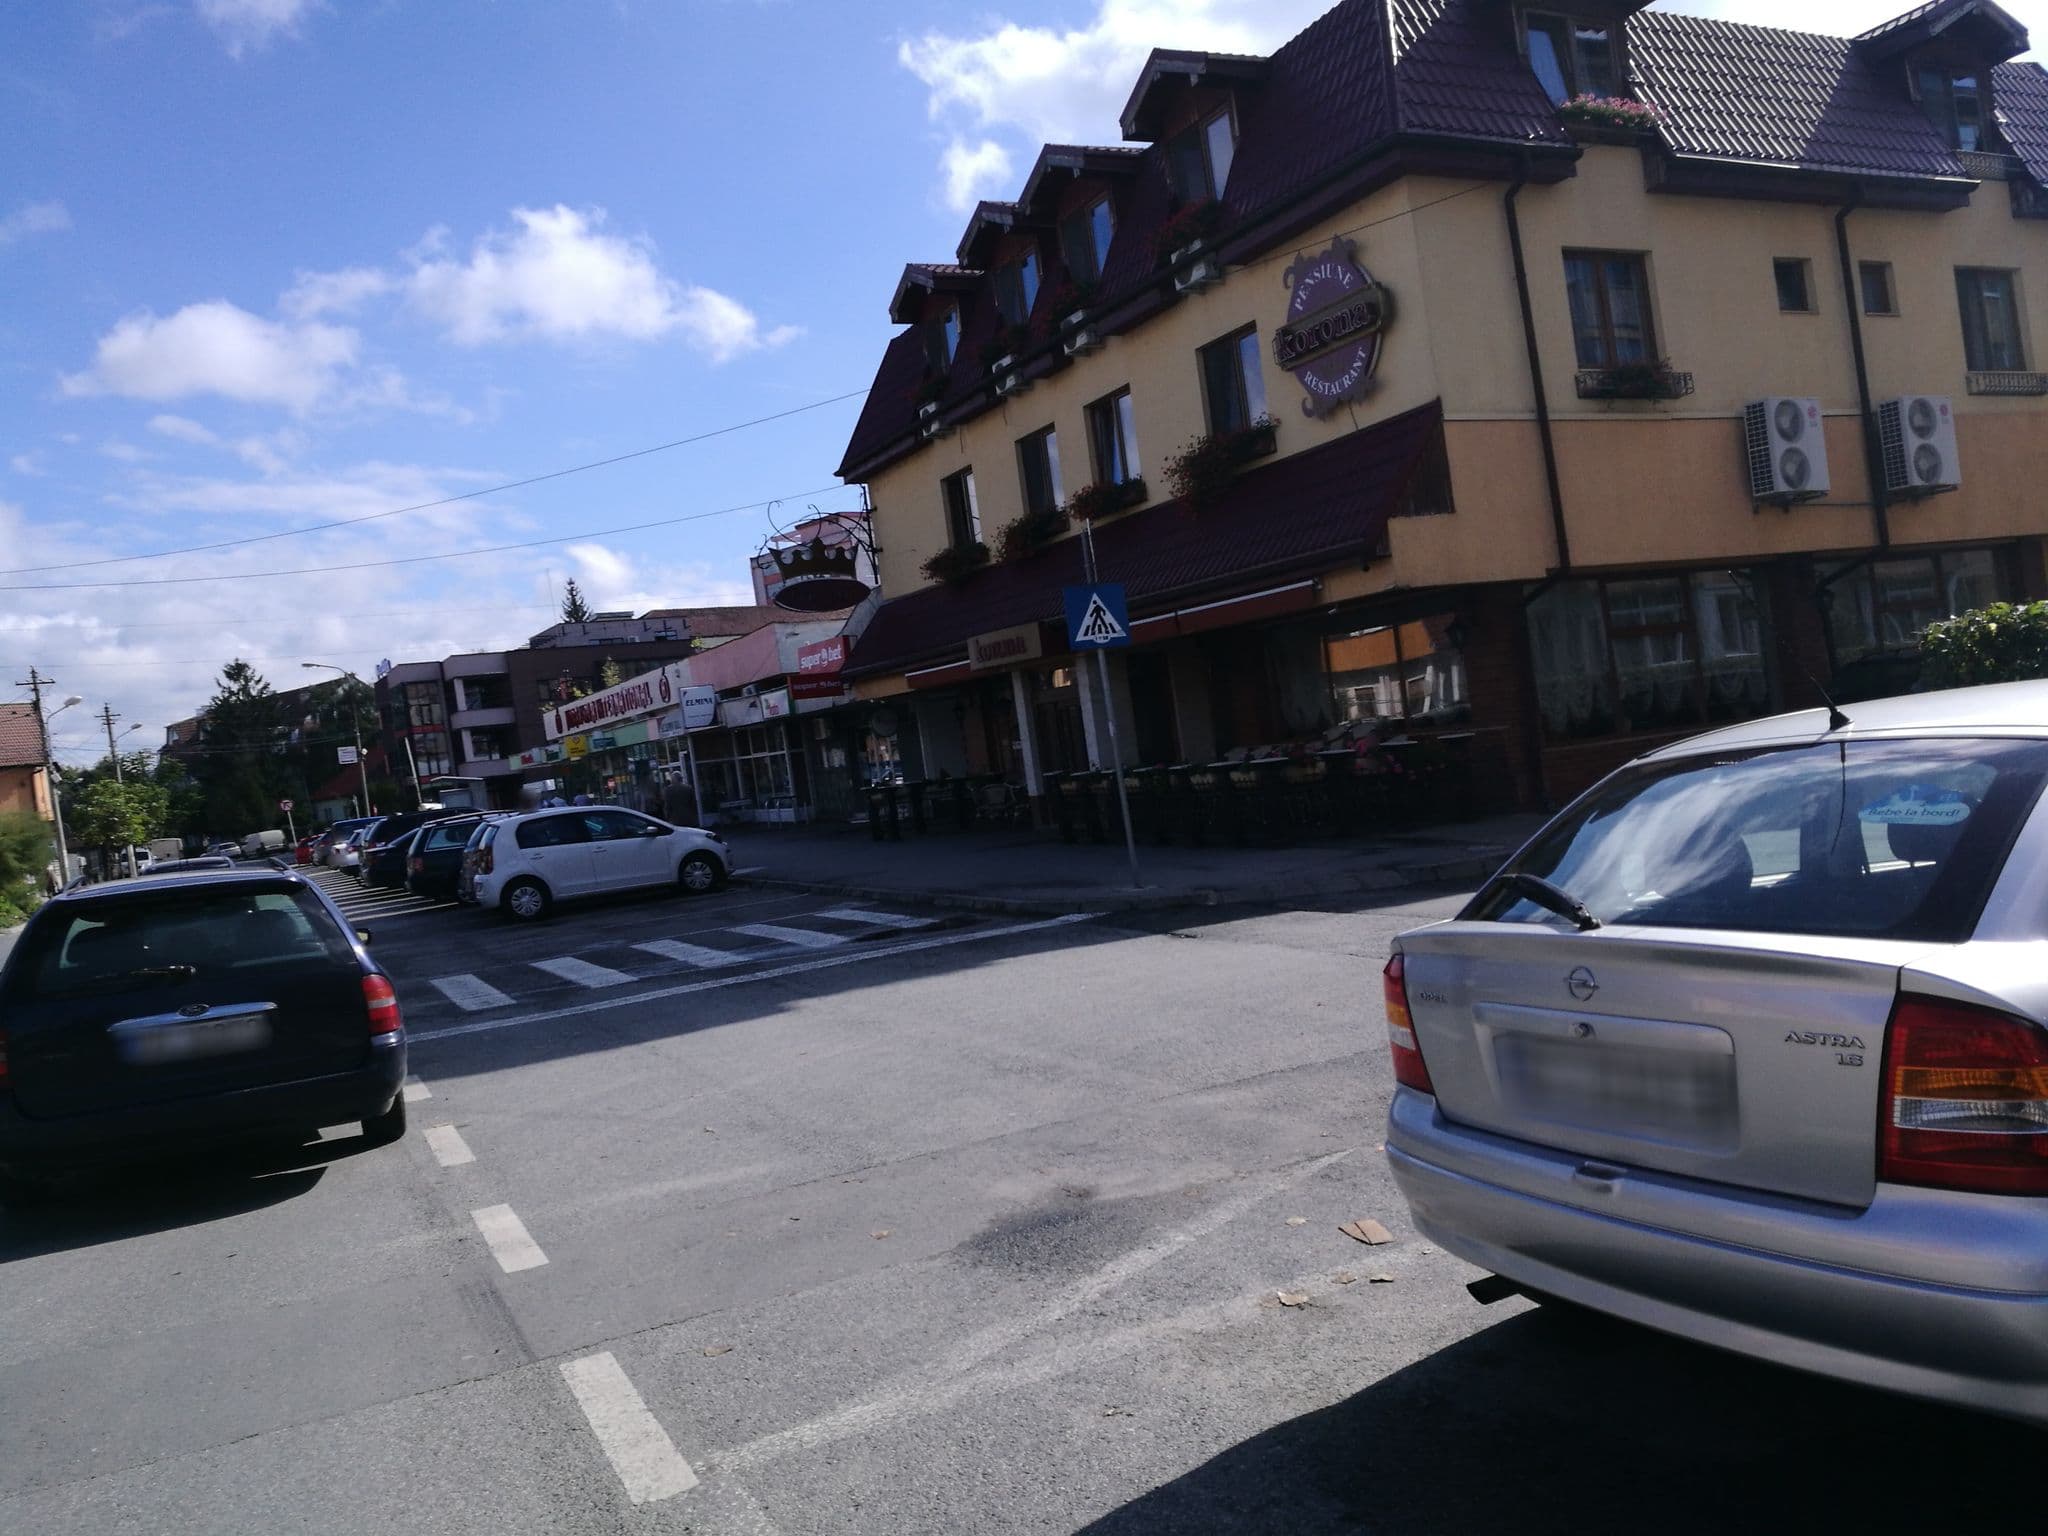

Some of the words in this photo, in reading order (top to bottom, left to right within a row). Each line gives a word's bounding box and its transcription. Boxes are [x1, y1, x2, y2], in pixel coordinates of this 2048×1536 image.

[1294, 264, 1354, 311] PENSIUNE
[1304, 347, 1369, 396] RESTAURANT
[685, 697, 713, 707] ELMINA
[1784, 1030, 1866, 1049] ASTRA
